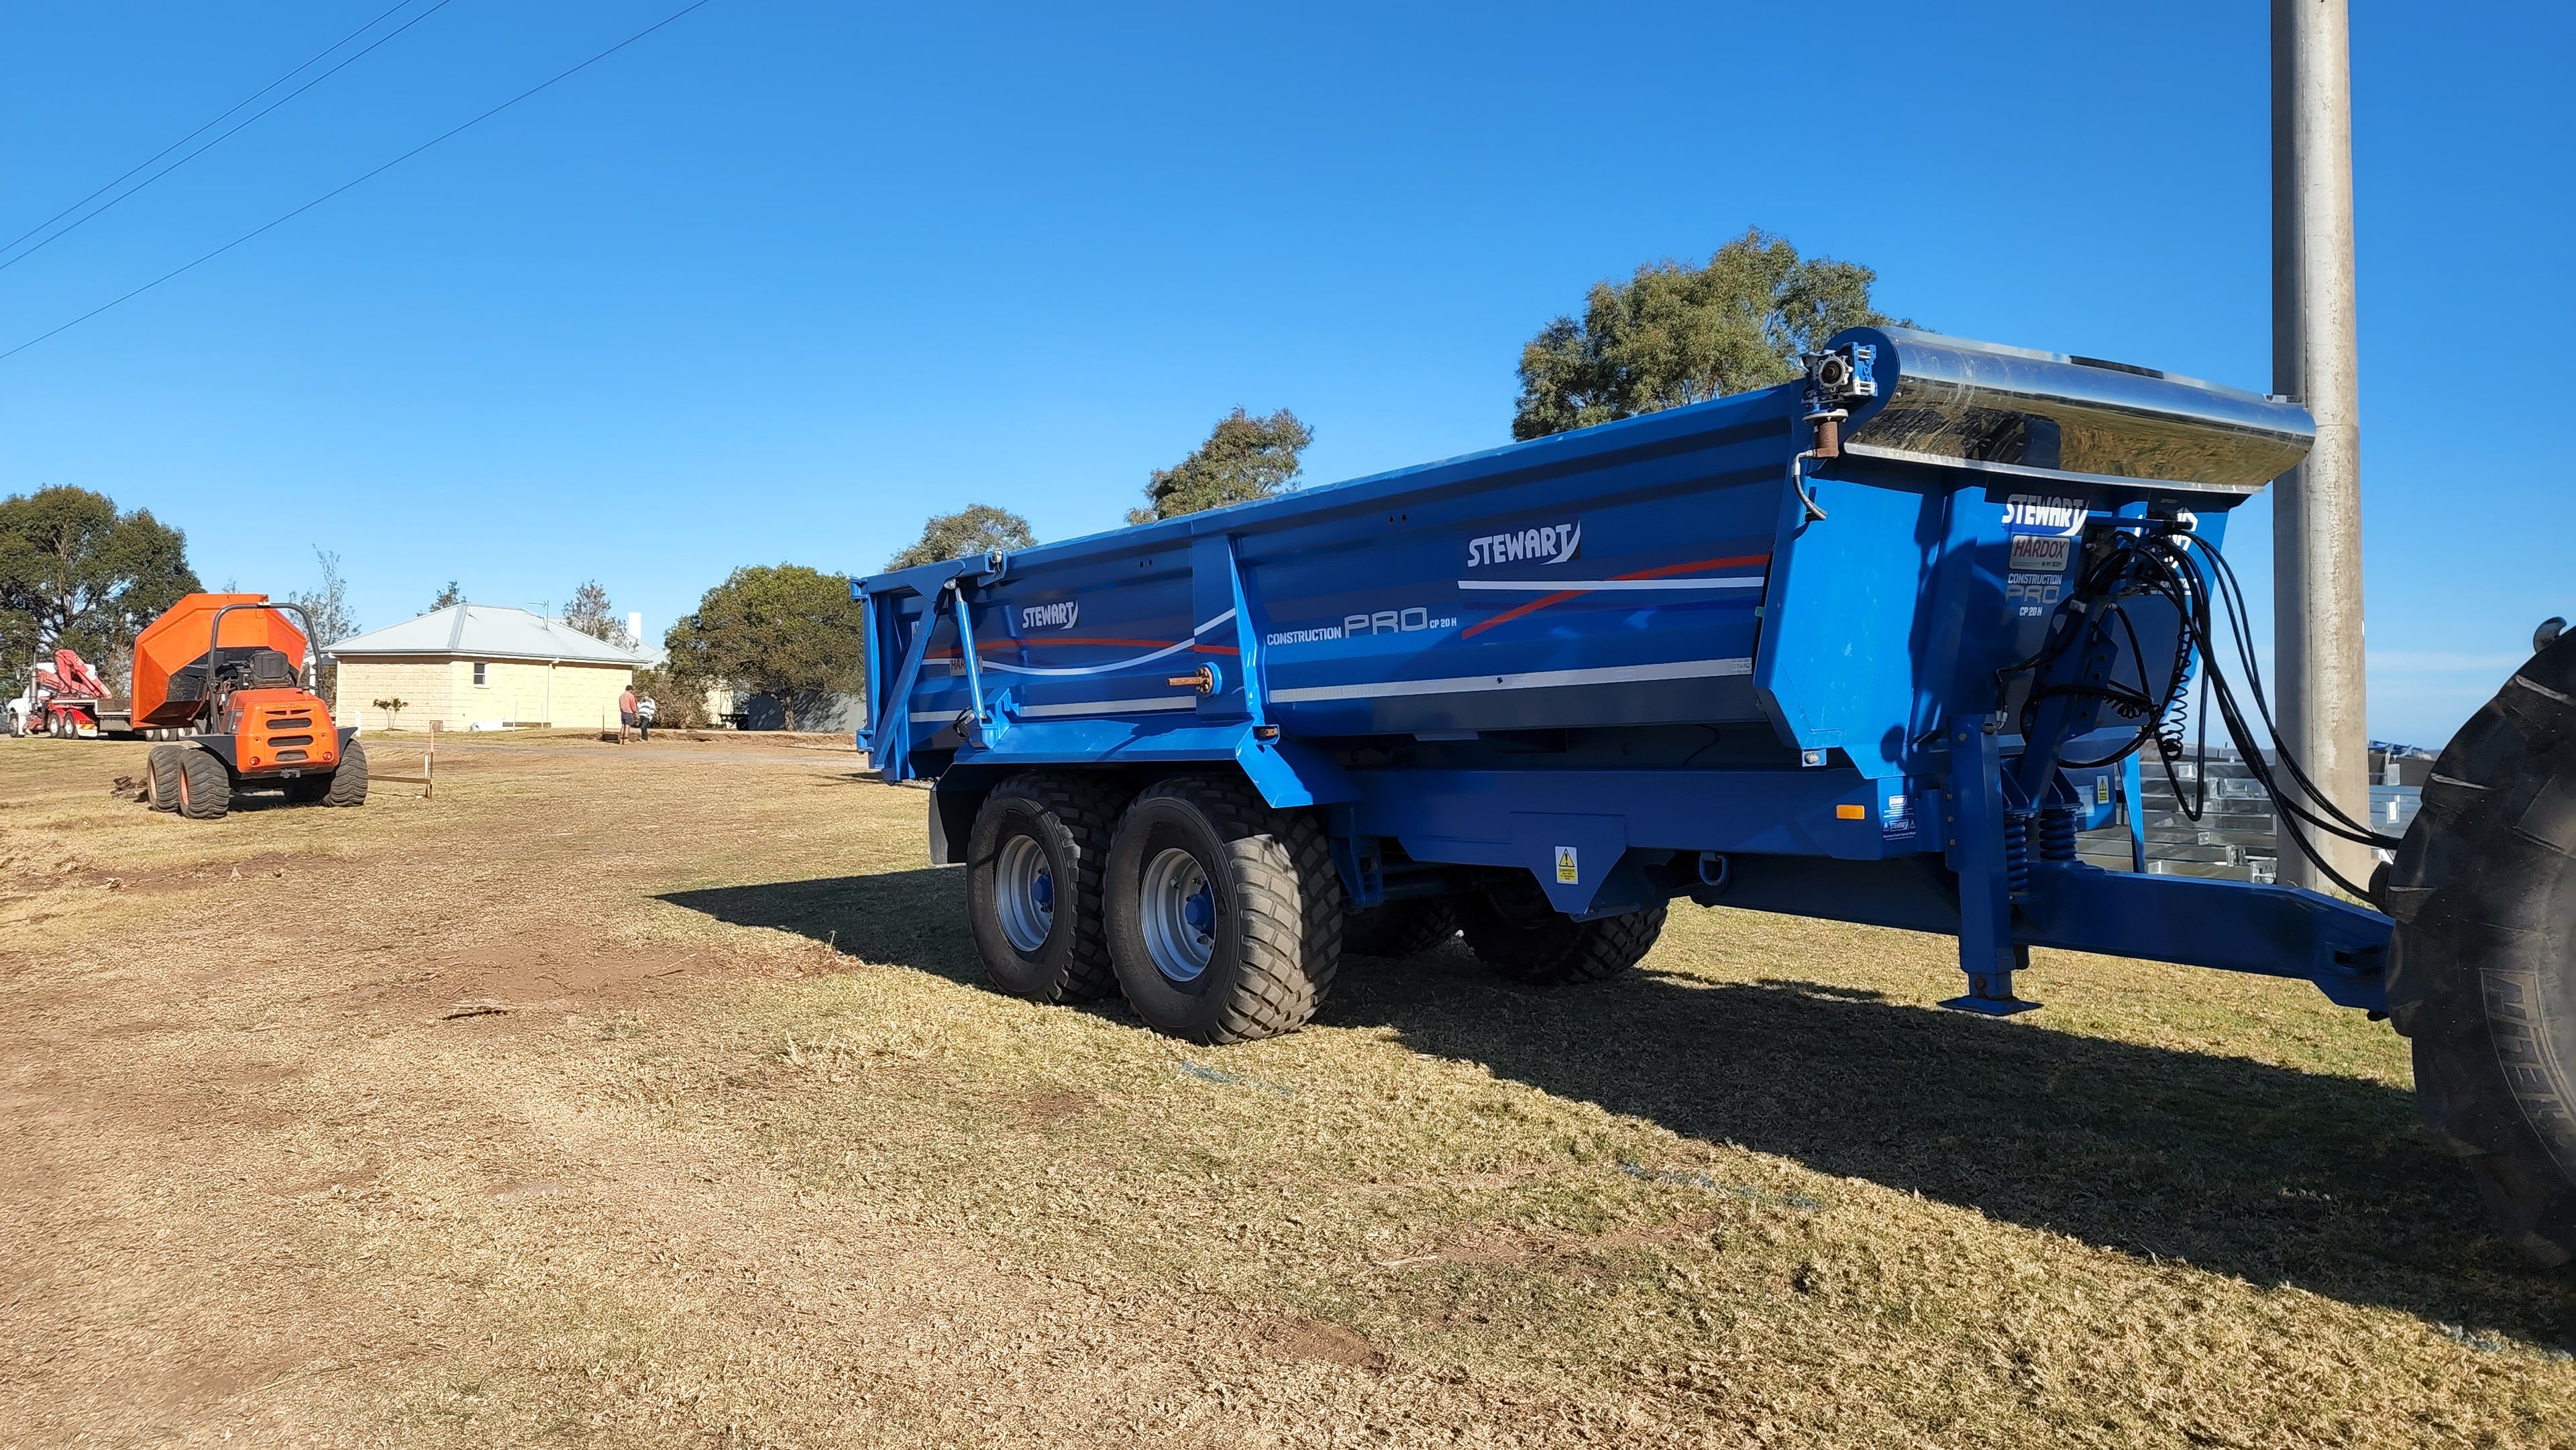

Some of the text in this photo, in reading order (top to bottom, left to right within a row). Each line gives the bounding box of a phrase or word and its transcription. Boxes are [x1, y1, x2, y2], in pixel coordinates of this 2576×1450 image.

[2002, 494, 2089, 536] STEWART
[1468, 520, 1580, 567] STEWART
[2014, 539, 2066, 559] HARDOX
[2008, 573, 2062, 585] CONSTRUCTION
[2004, 585, 2059, 604] PRO
[1022, 600, 1078, 630] STEWART
[2019, 607, 2043, 616] CP 20 H
[1267, 607, 1457, 646] CONSTRUCTION PRO CP 20 H
